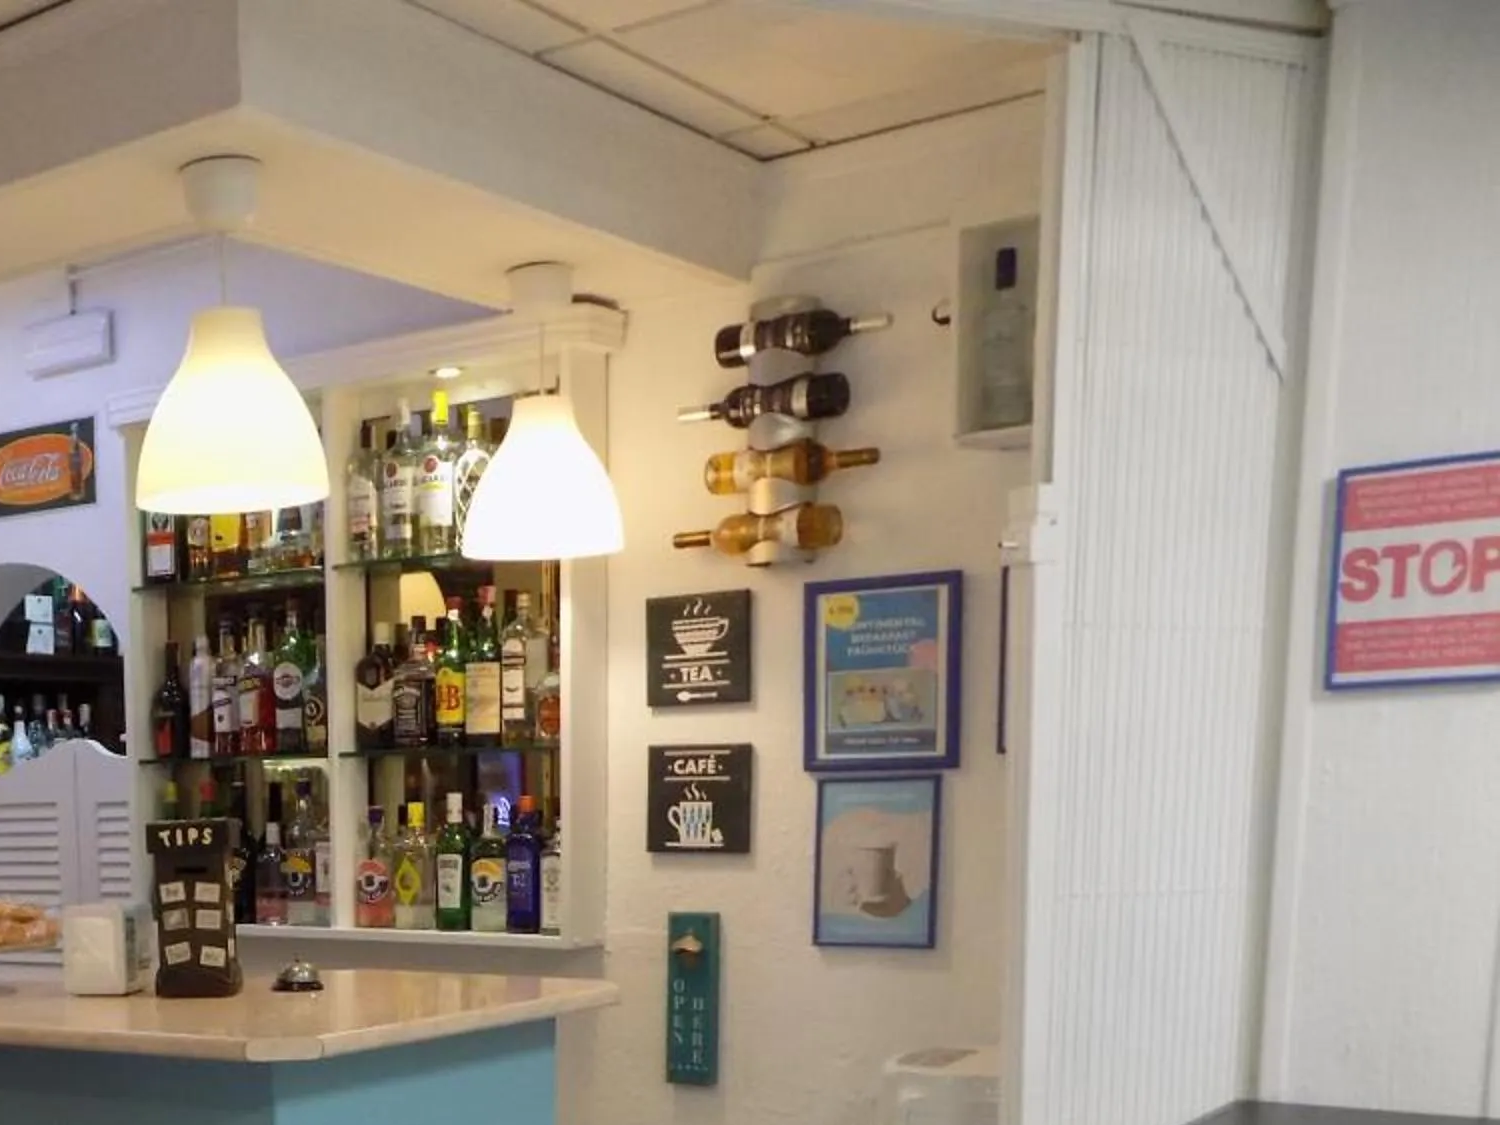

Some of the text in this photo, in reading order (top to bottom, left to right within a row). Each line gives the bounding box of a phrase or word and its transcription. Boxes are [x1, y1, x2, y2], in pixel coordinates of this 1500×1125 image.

[1339, 534, 1500, 604] STOP
[680, 665, 713, 683] TEA
[673, 753, 717, 775] CAFÉ
[158, 826, 213, 848] TIPS
